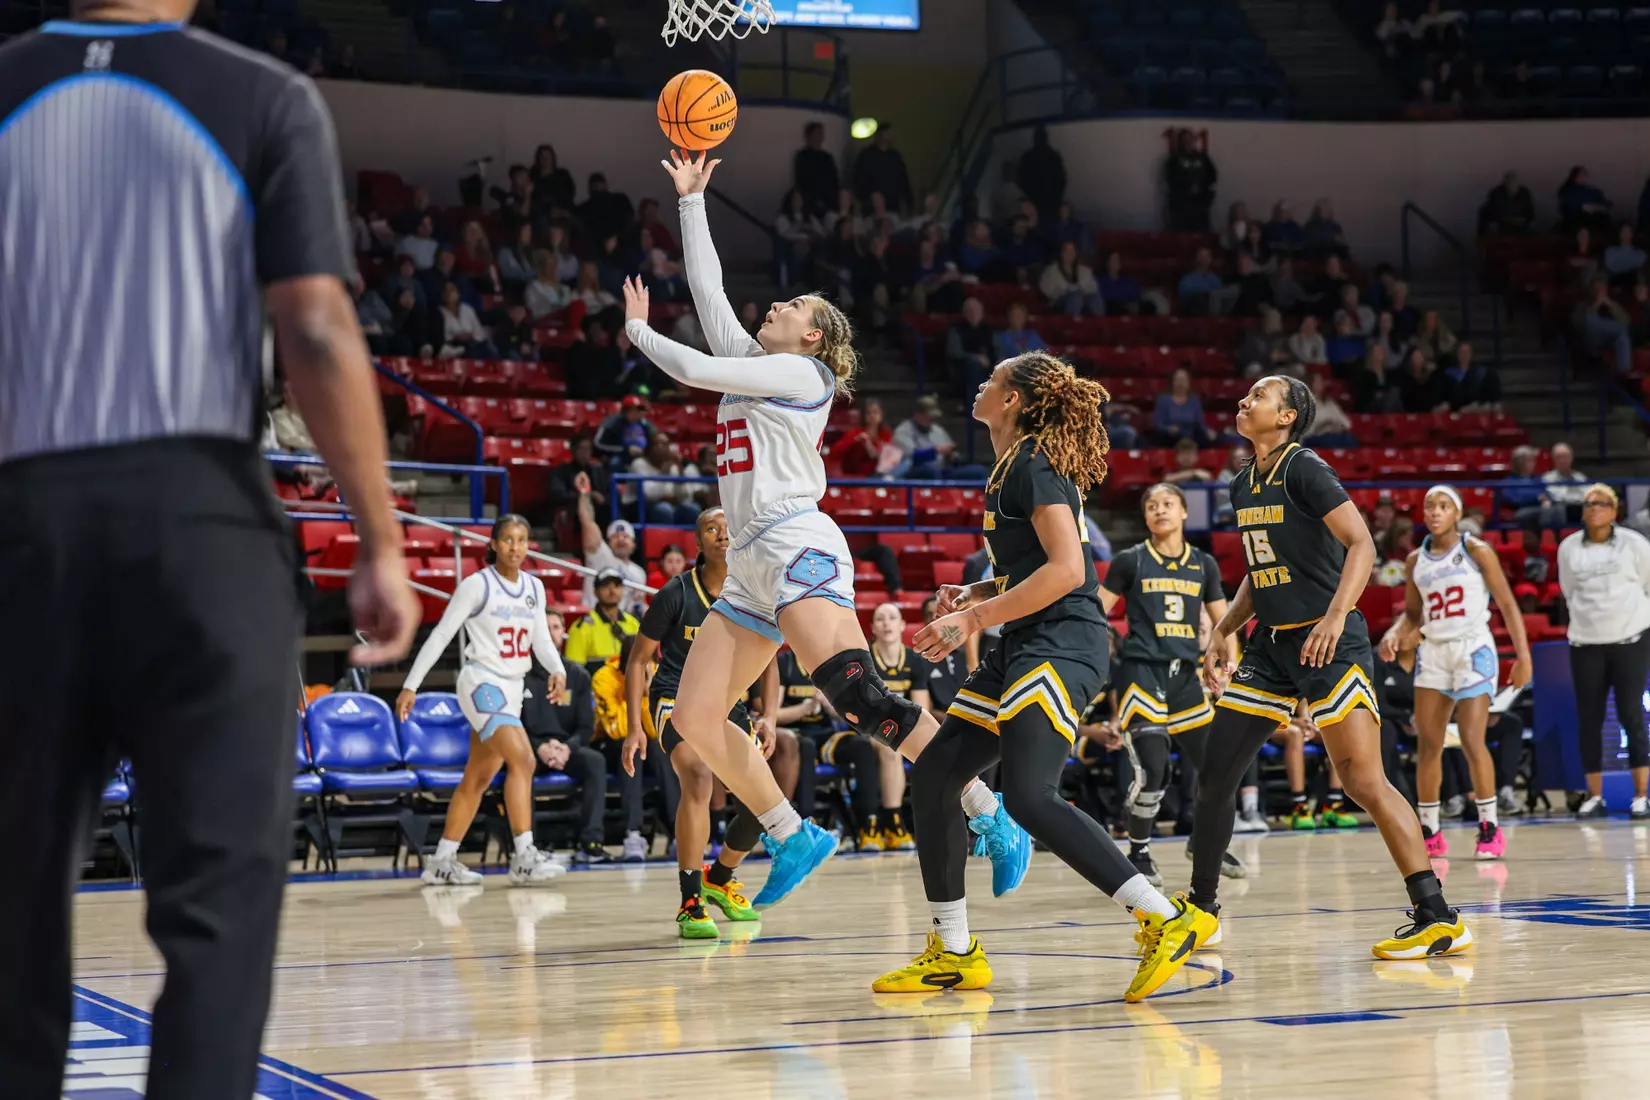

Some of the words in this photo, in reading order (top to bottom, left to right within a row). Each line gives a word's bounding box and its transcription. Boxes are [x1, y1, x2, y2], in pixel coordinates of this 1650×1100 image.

[716, 418, 754, 477] 25
[1242, 529, 1276, 567] 15
[1250, 566, 1291, 589] TATE
[1164, 594, 1185, 621] 3
[1427, 585, 1465, 621] 22
[497, 626, 533, 658] 30
